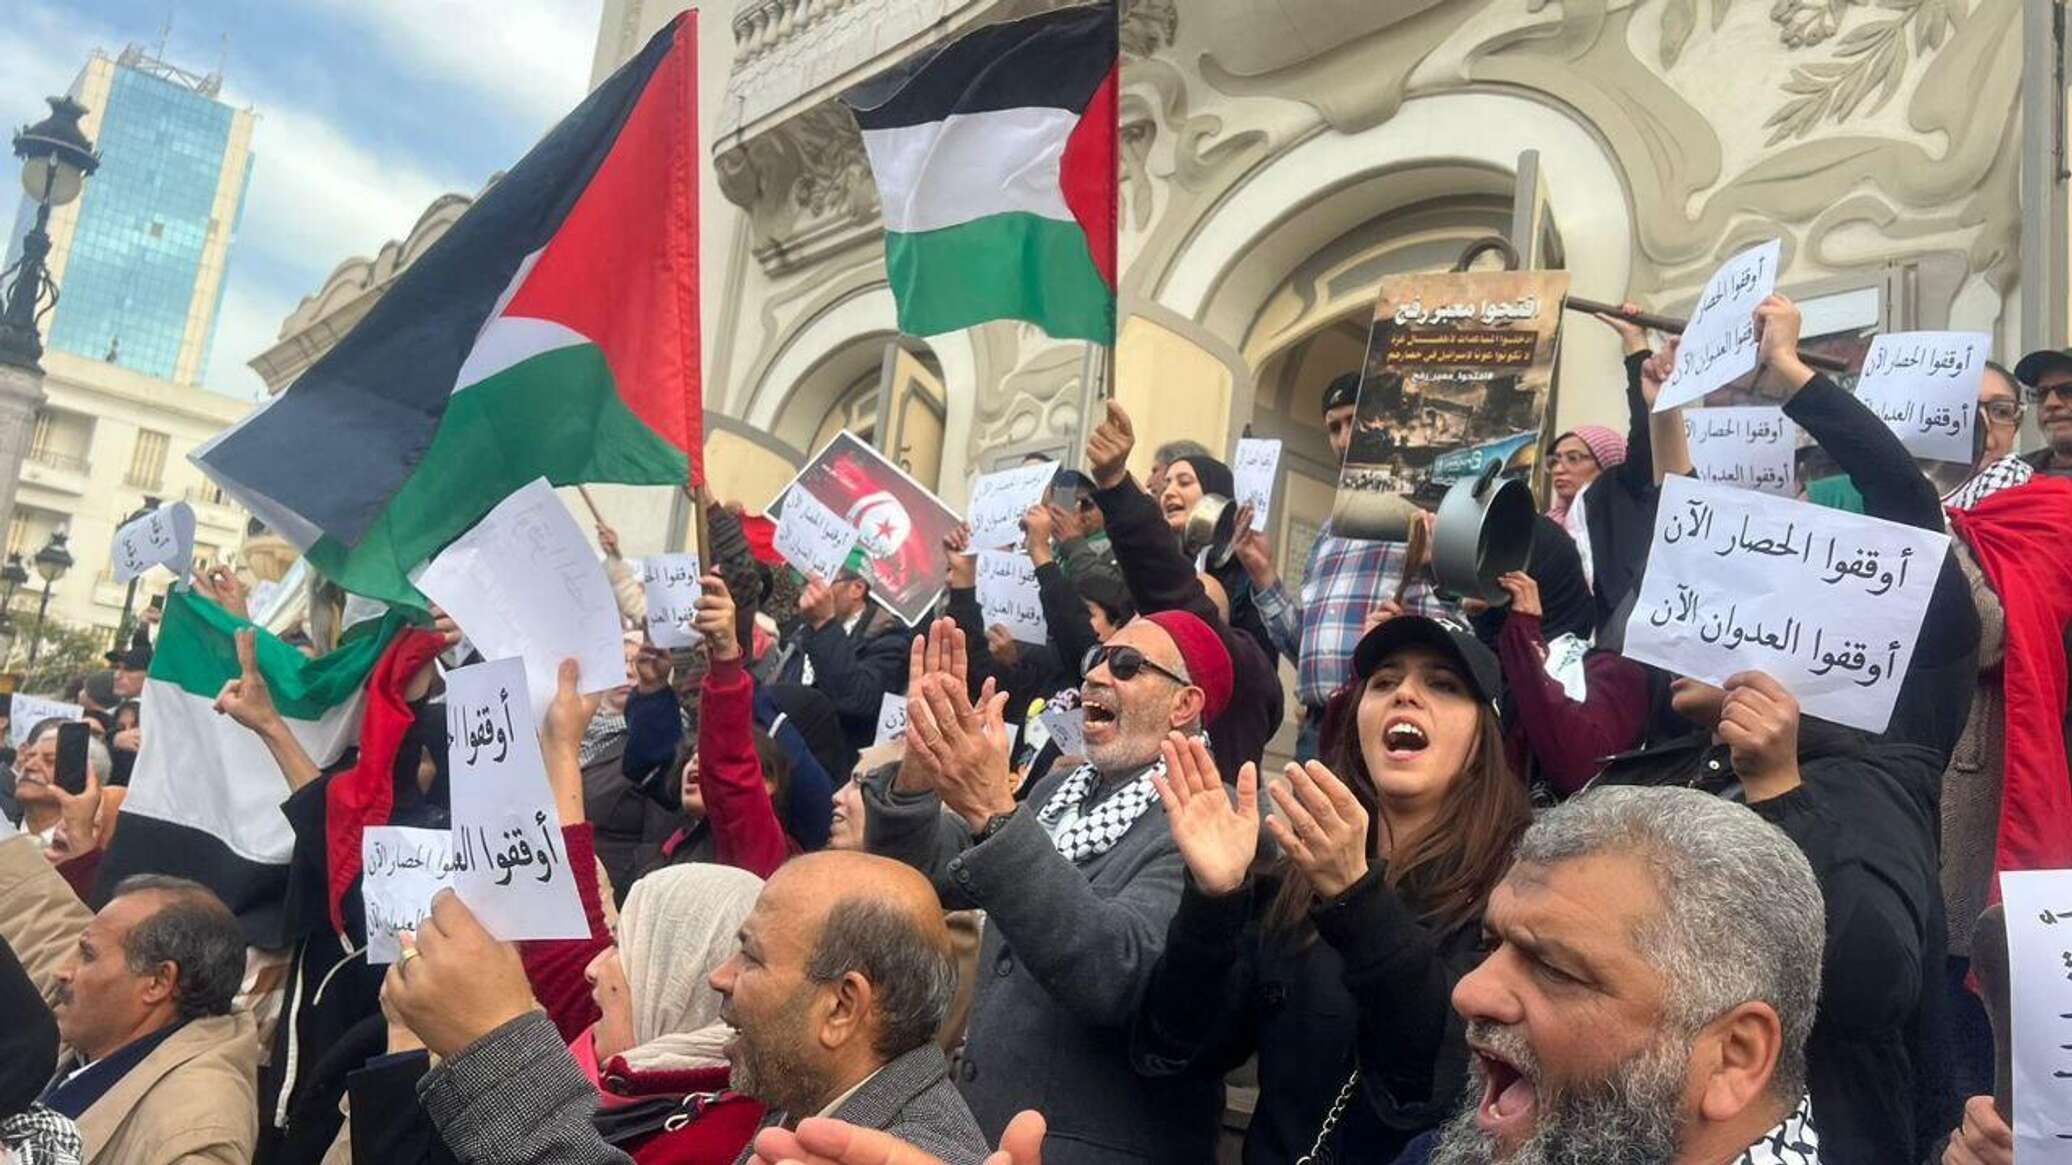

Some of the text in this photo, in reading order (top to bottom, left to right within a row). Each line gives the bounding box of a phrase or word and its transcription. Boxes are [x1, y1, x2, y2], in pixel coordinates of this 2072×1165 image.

[1395, 295, 1541, 326] افتحوا معبر رفح
[1927, 345, 1973, 378] أوقفوا
[1698, 418, 1740, 443] الحصار
[1745, 418, 1784, 444] أوقفوا
[1919, 402, 1968, 436] أوقفوا
[1750, 463, 1790, 489] أوقفوا
[1664, 500, 1913, 595] أوقفوا الحصار الآن
[1650, 584, 1901, 686] أوقفوا العدوان الآن
[463, 687, 514, 765] أوقفوا
[480, 810, 558, 886] أوقفوا
